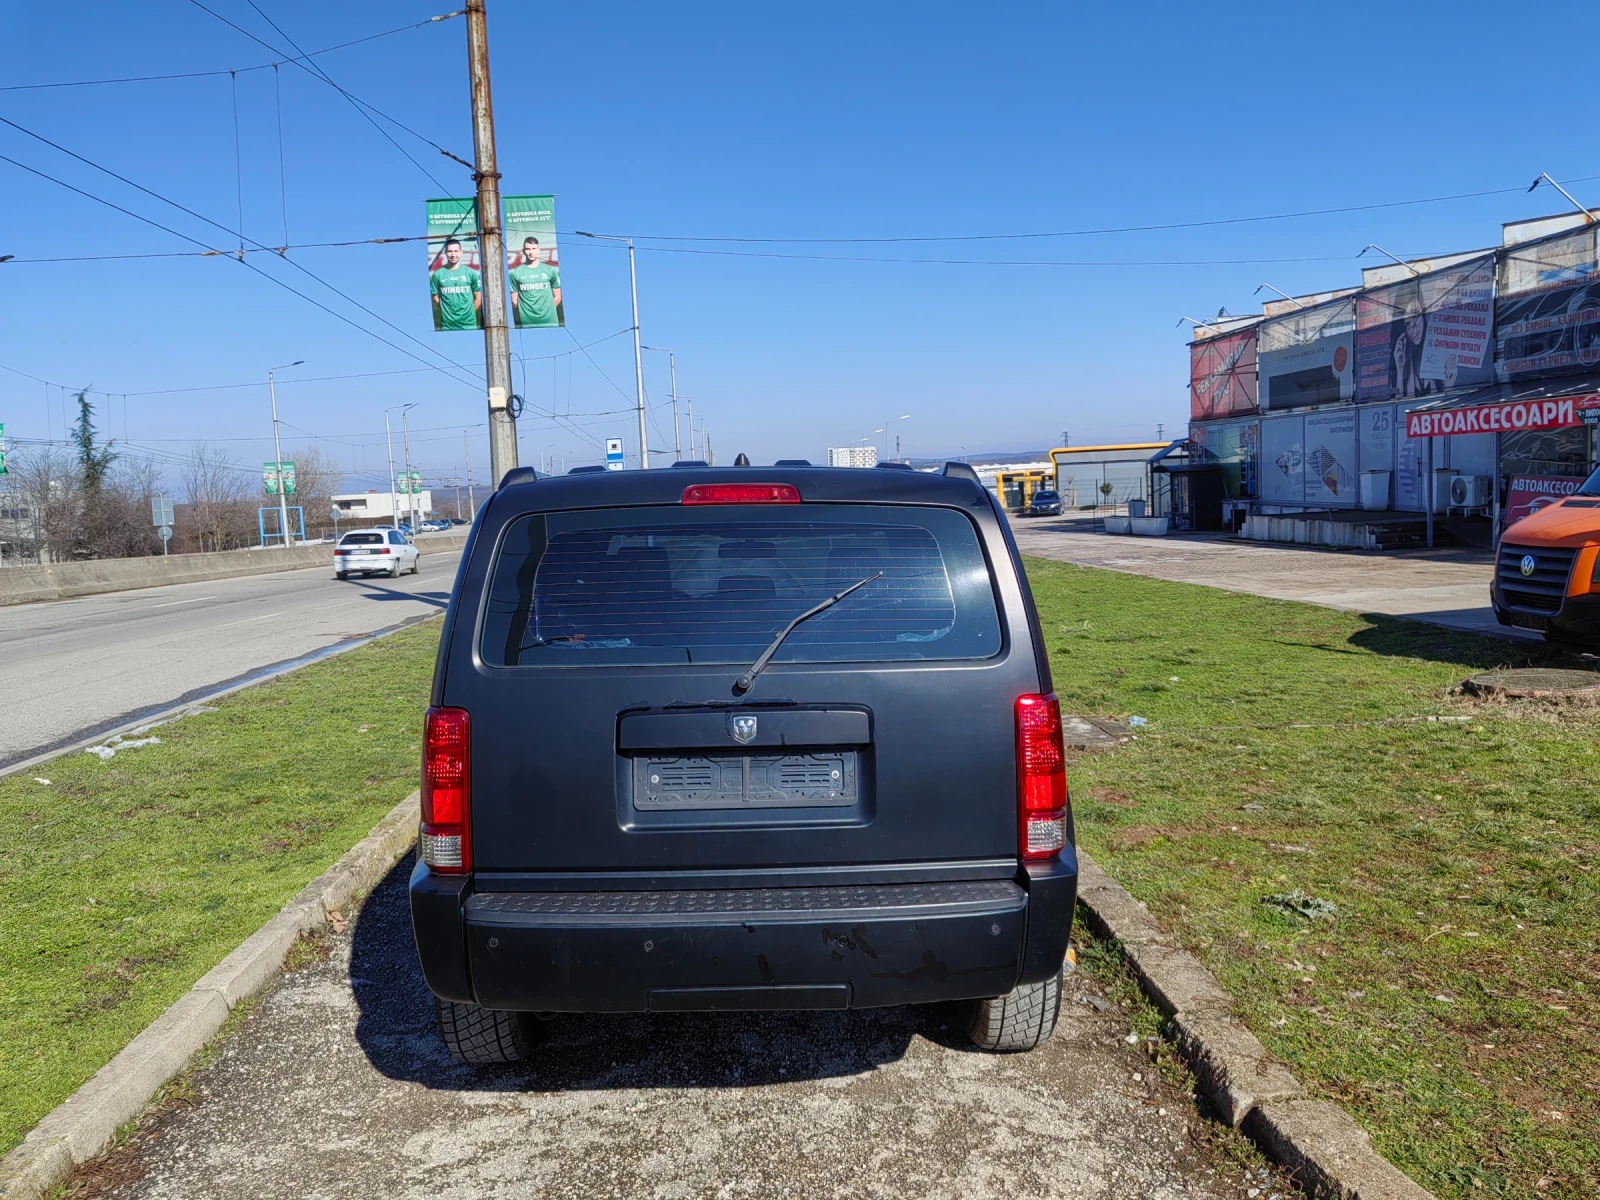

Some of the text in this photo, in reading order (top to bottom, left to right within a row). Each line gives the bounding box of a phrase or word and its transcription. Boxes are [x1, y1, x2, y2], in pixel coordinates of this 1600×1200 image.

[440, 285, 470, 294] WINBET
[519, 282, 549, 291] WINBET
[1461, 315, 1486, 326] РЕКЛАМА
[1433, 326, 1460, 337] РЕКЛАМНИ
[1301, 347, 1325, 358] CHOCOLATE
[1460, 343, 1482, 352] ПЕЧАТИ
[1372, 411, 1389, 432] 25
[1409, 399, 1573, 436] АВТОАКСЕСОАРИ
